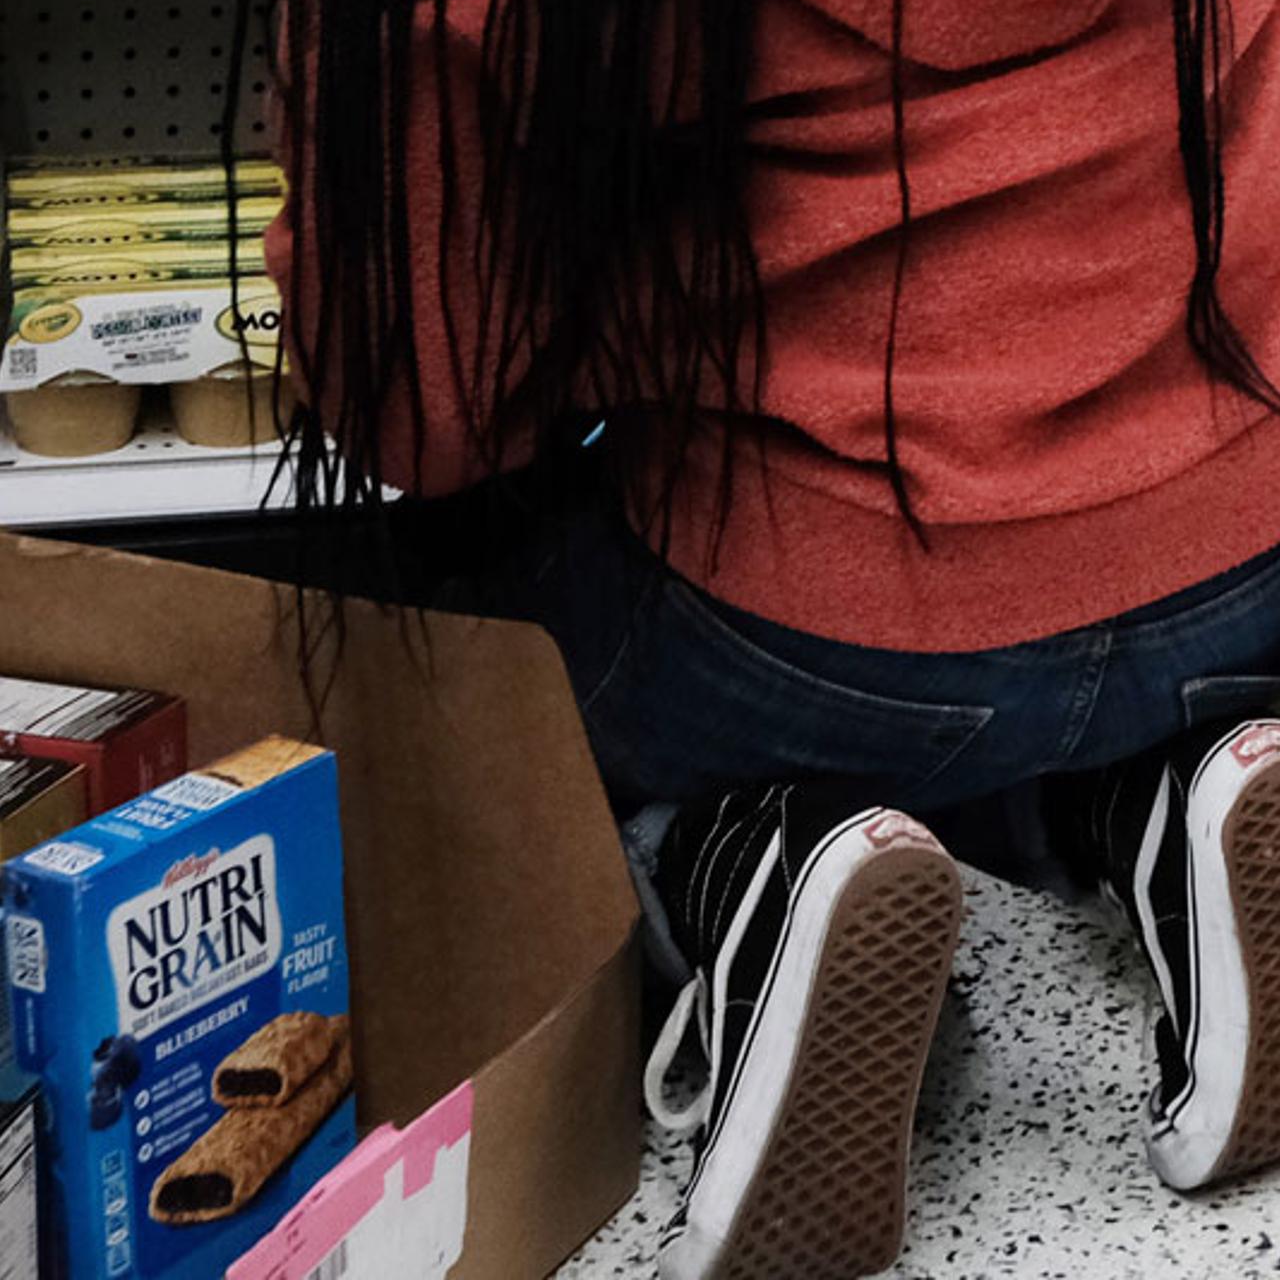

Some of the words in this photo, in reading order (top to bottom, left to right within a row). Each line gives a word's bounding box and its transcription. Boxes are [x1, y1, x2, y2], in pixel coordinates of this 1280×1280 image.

[125, 855, 262, 973] NUTRI
[129, 893, 267, 1009] GRAIN
[282, 937, 336, 979] FRUIT
[155, 996, 249, 1061] BLUEBERRY
